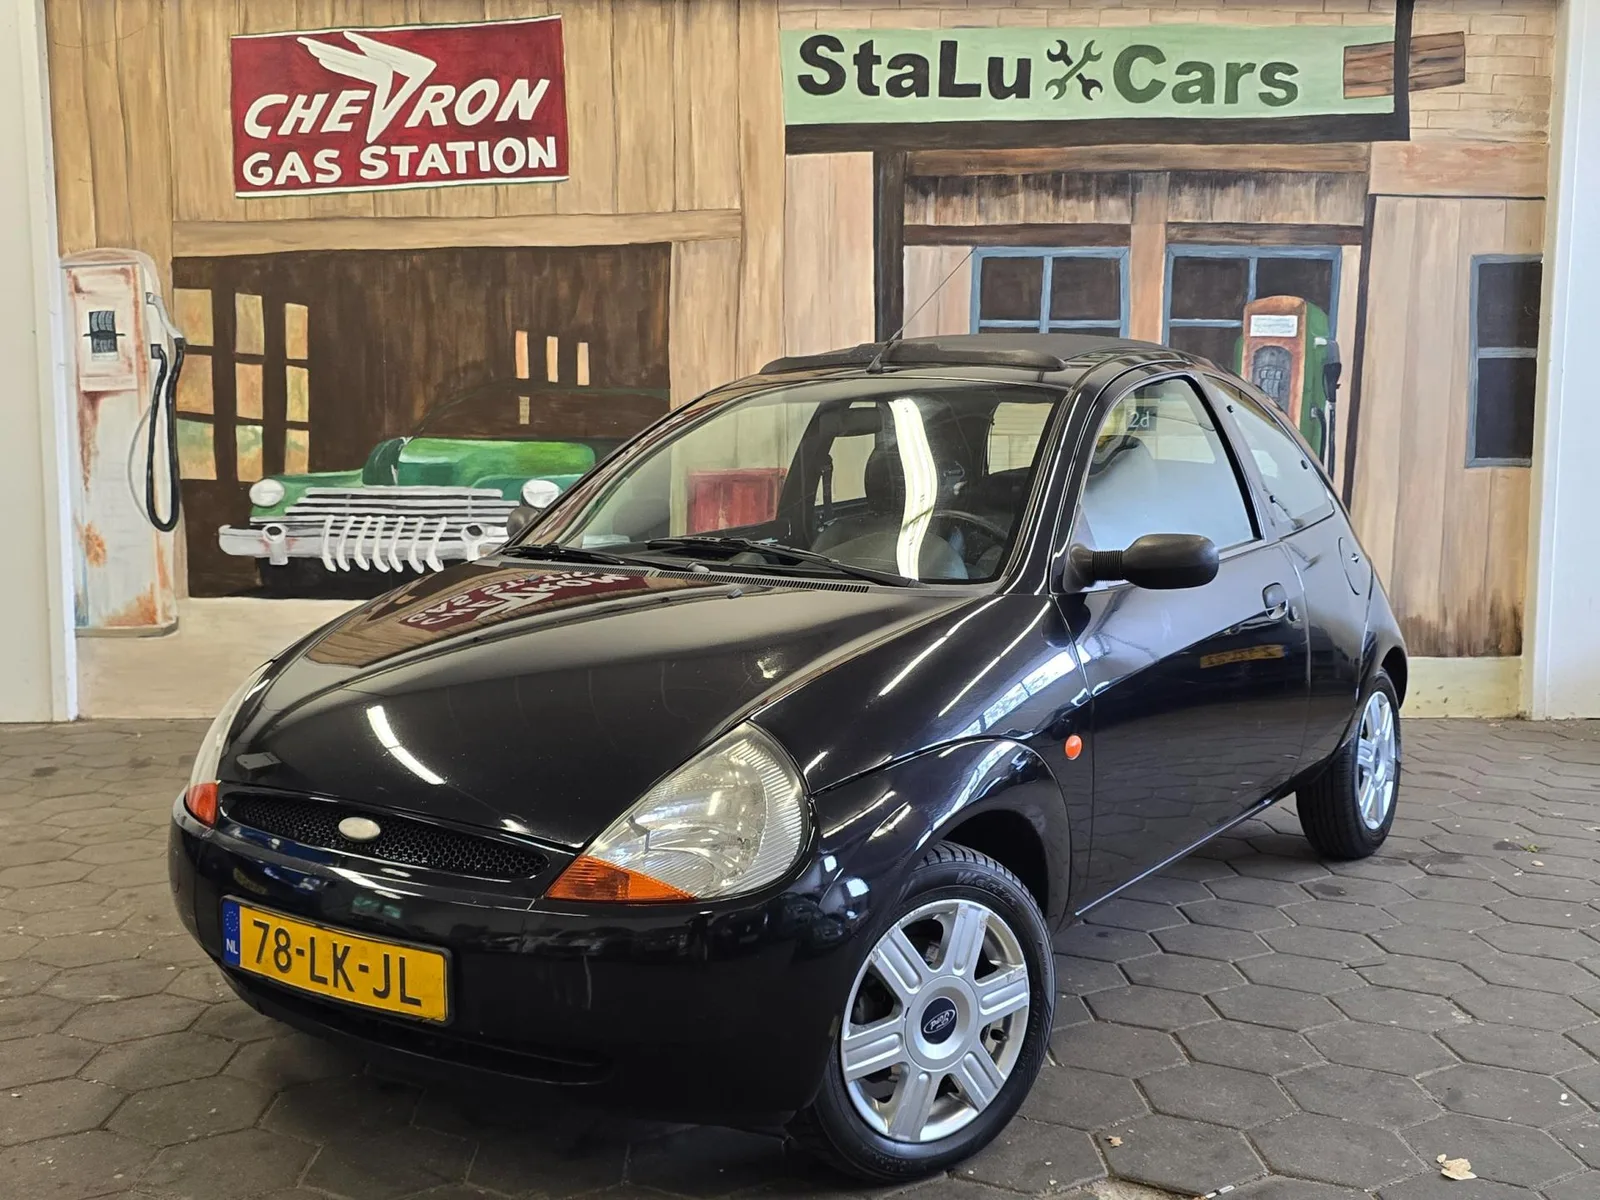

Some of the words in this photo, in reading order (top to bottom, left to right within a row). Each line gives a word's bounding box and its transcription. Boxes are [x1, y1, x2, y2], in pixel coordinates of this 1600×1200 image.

[243, 62, 551, 144] CHEVRON
[797, 34, 1032, 100] StaLu
[1112, 44, 1300, 107] Cars
[242, 149, 342, 187] GAS
[359, 136, 558, 180] STATION
[226, 938, 239, 955] NL
[253, 920, 422, 1007] 78-LK-JL
